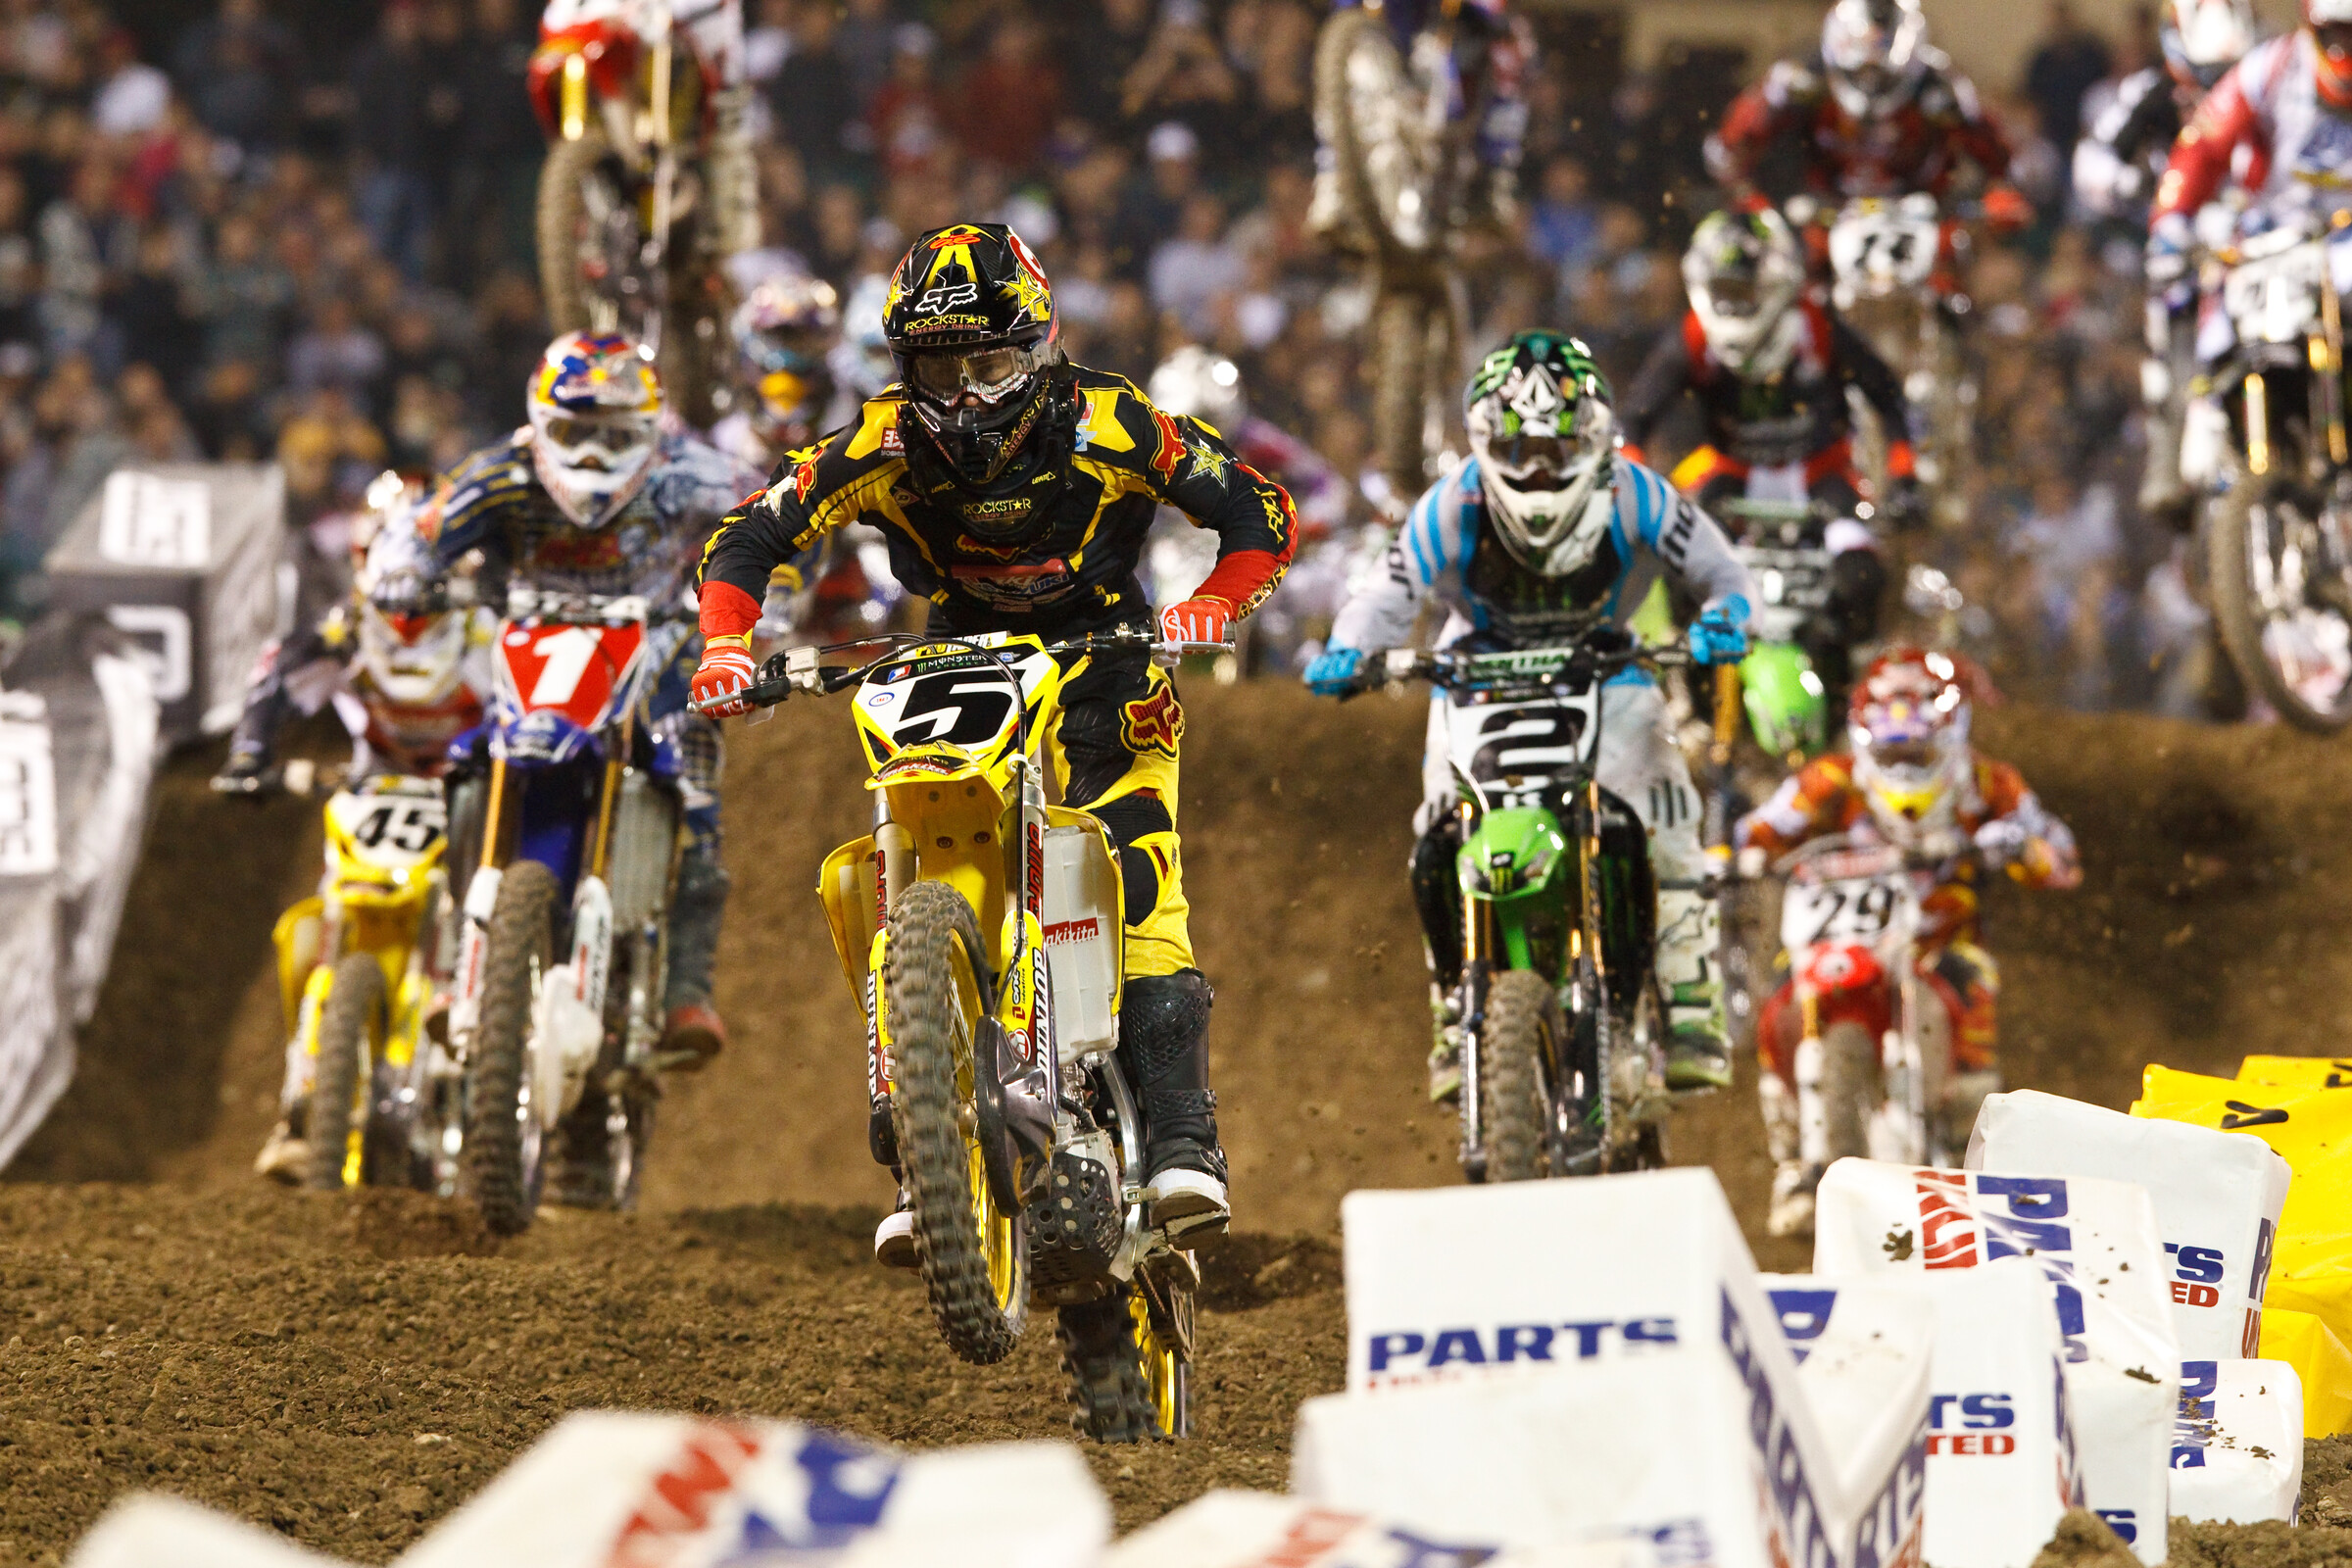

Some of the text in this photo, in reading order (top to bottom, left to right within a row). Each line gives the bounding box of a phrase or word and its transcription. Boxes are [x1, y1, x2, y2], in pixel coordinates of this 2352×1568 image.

[909, 323, 948, 335] ENERGY
[529, 627, 604, 706] 1
[892, 669, 1025, 745] 5
[1470, 707, 1587, 785] 2
[867, 969, 876, 1096] DUNLOP
[1033, 947, 1049, 1074] DUNLOP
